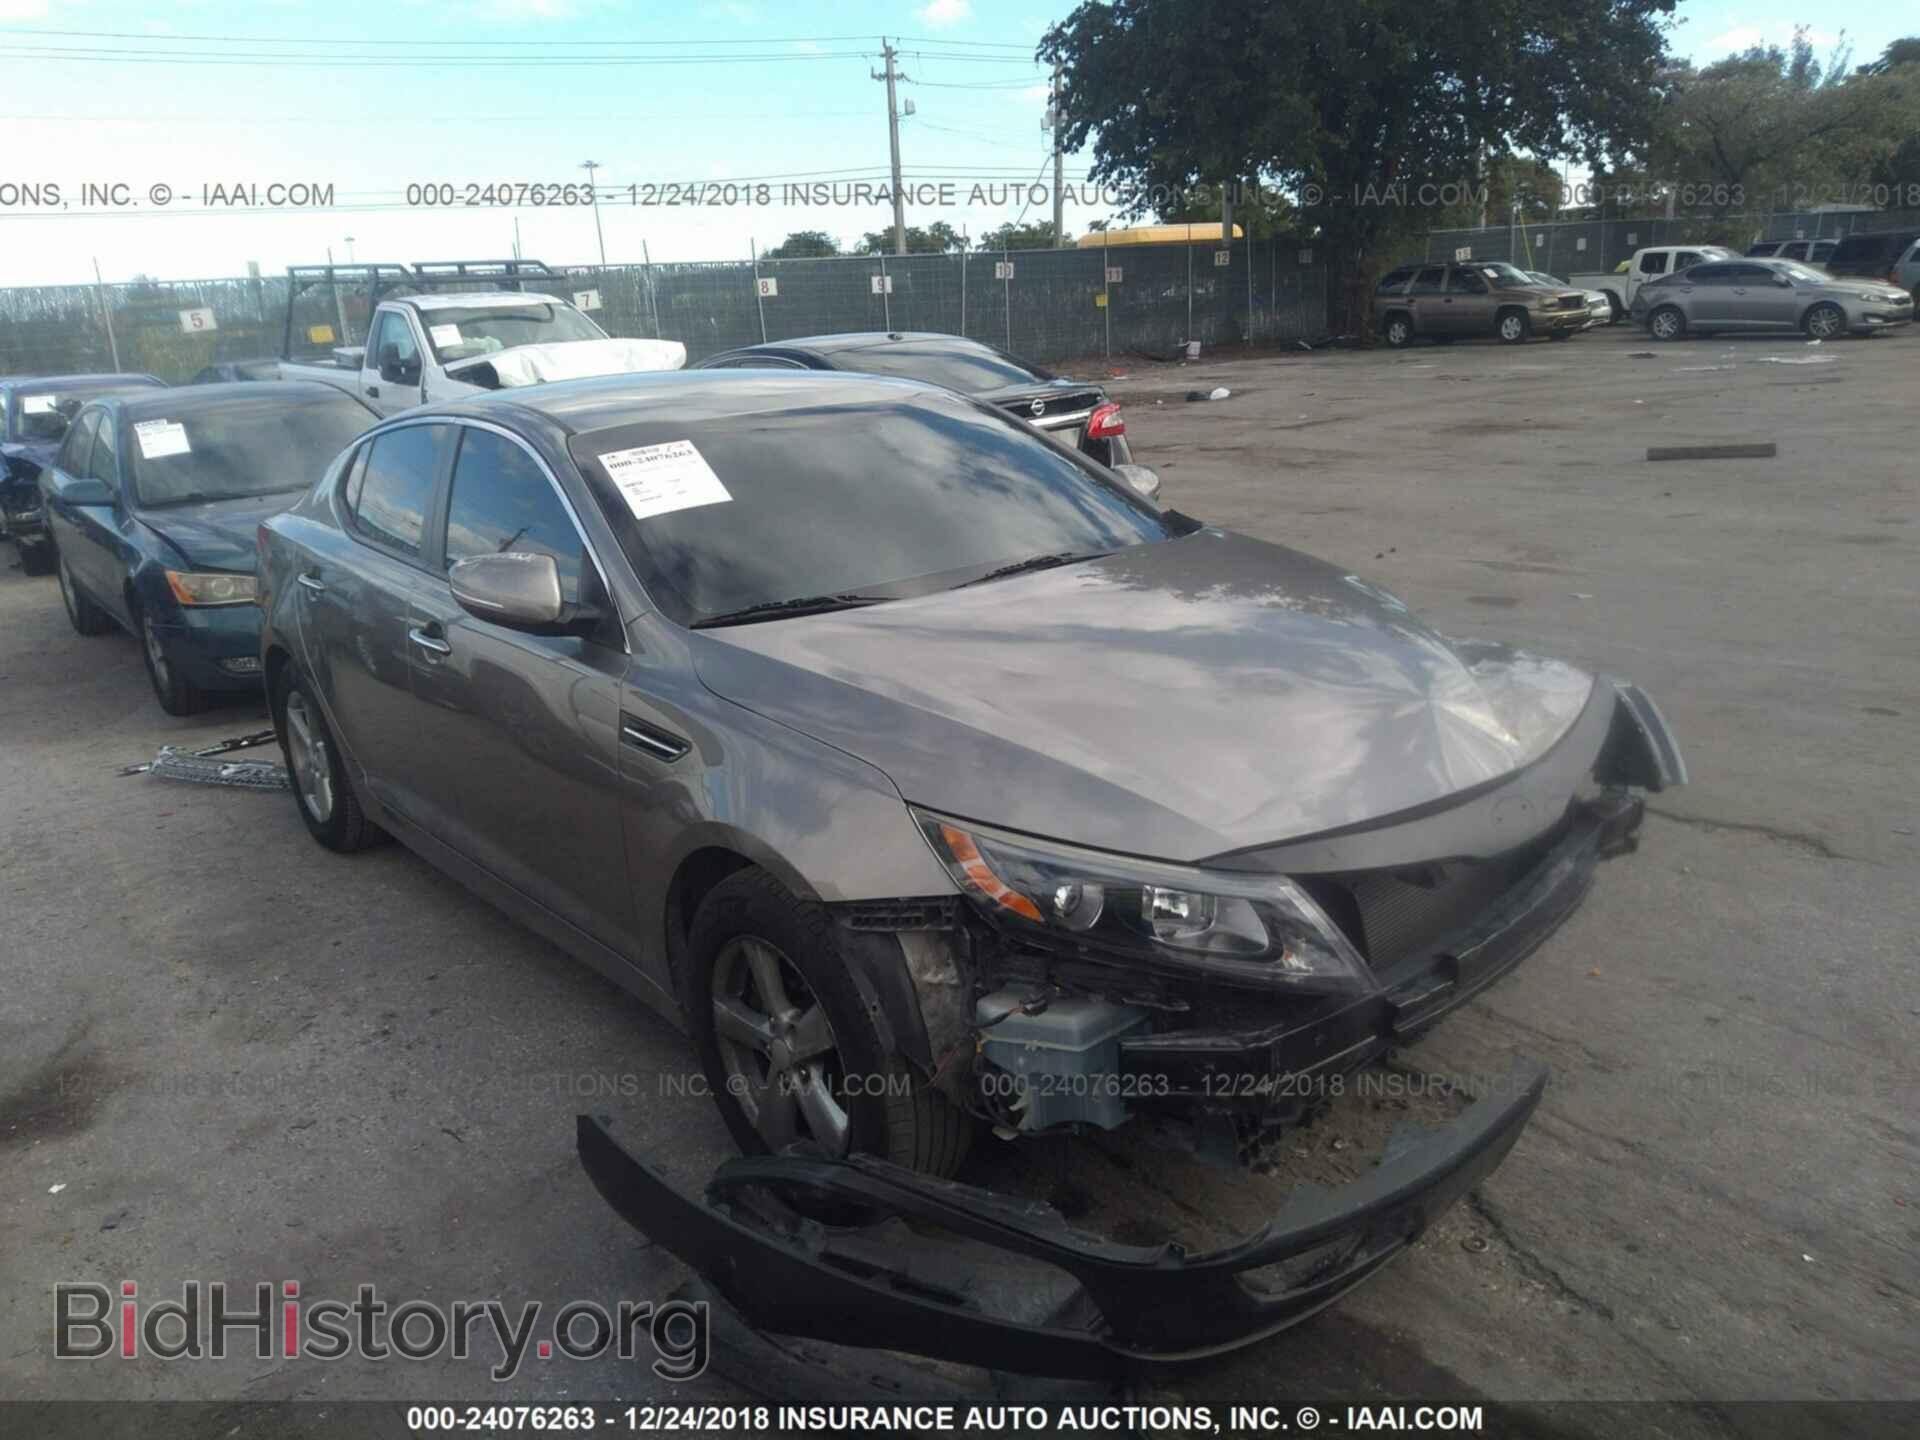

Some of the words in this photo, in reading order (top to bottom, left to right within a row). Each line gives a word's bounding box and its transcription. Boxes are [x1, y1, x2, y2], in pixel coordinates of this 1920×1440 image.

[760, 280, 770, 294] 8
[580, 294, 590, 307] 7
[190, 311, 204, 328] 5
